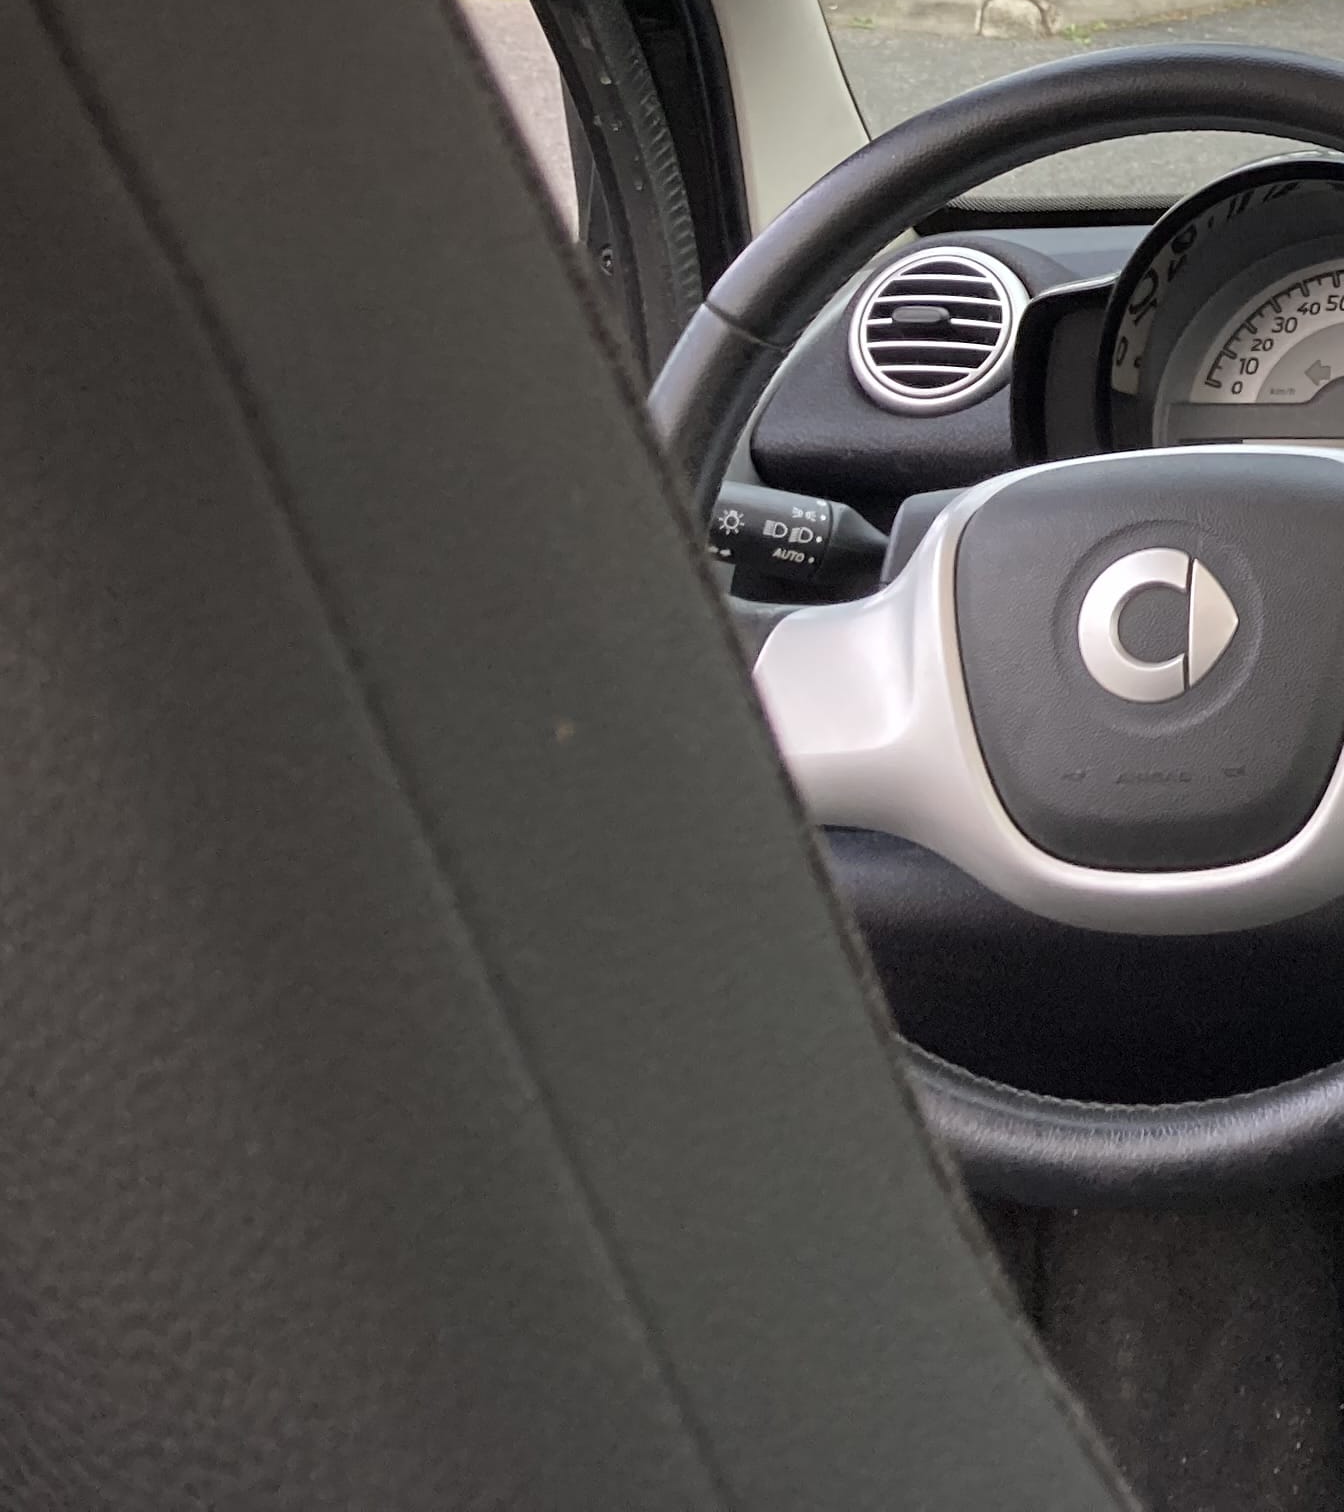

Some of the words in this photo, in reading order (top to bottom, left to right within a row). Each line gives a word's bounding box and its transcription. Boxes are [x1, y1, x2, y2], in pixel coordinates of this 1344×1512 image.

[1297, 301, 1321, 316] 40
[1271, 316, 1298, 334] 30
[1250, 337, 1274, 352] 20
[1239, 357, 1259, 375] 10
[1231, 380, 1244, 395] 0
[772, 547, 805, 564] AUTO
